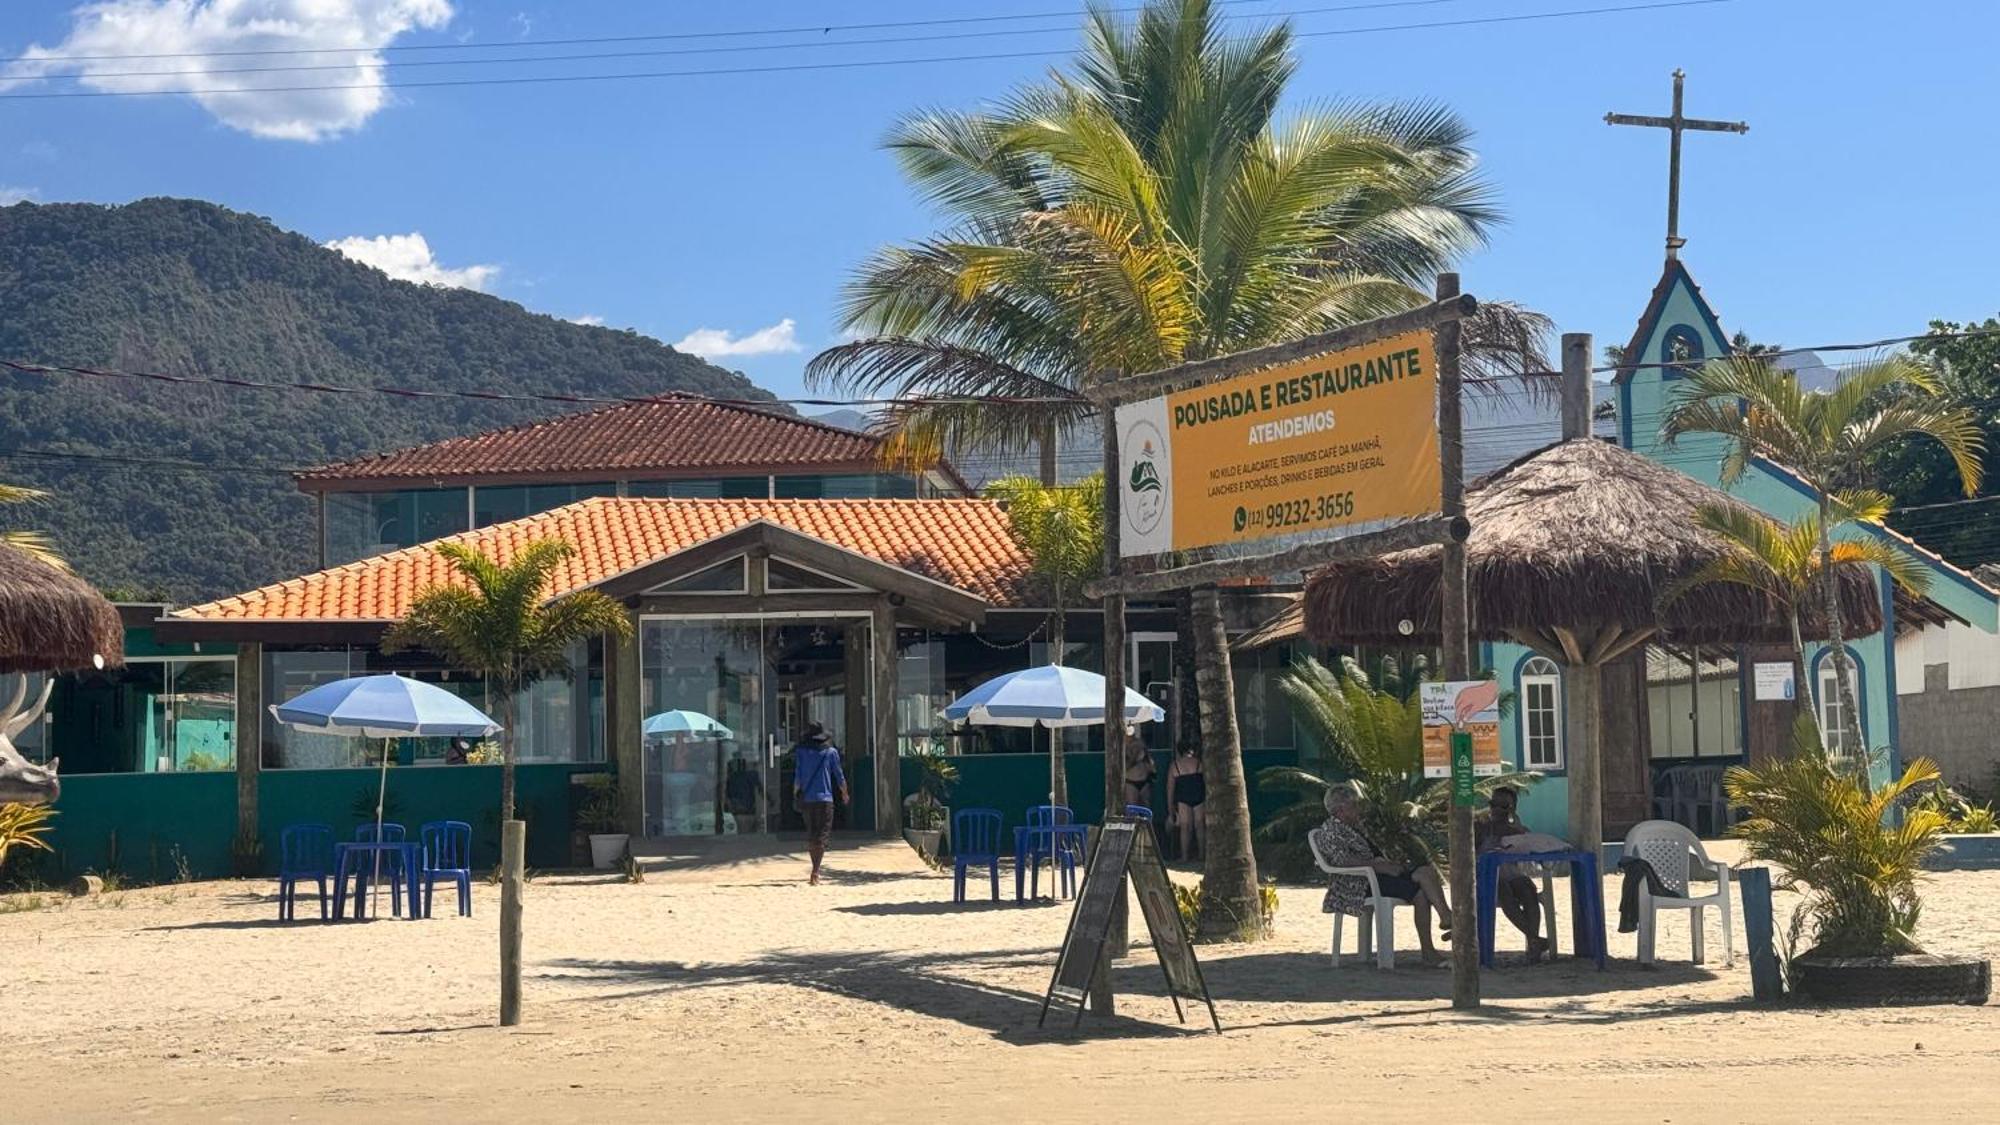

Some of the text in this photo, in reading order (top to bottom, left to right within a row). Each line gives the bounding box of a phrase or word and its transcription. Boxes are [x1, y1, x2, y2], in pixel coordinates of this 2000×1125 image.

[1175, 347, 1421, 430] POUSADA E RESTAURANTE
[1248, 410, 1335, 446] ATENDEMOS
[1207, 482, 1239, 498] LANCHES
[1281, 470, 1308, 485] DRINKS
[1307, 469, 1314, 481] E
[1314, 463, 1346, 479] BEBIDAS
[1346, 461, 1358, 473] EM
[1359, 455, 1385, 471] GERAL
[1209, 468, 1220, 480] NO
[1221, 465, 1236, 478] KILO
[1281, 450, 1317, 468] SERVIMOS
[1318, 444, 1337, 461] CAFÉ
[1339, 443, 1350, 457] DA
[1248, 490, 1354, 529] (12) 99232-3656
